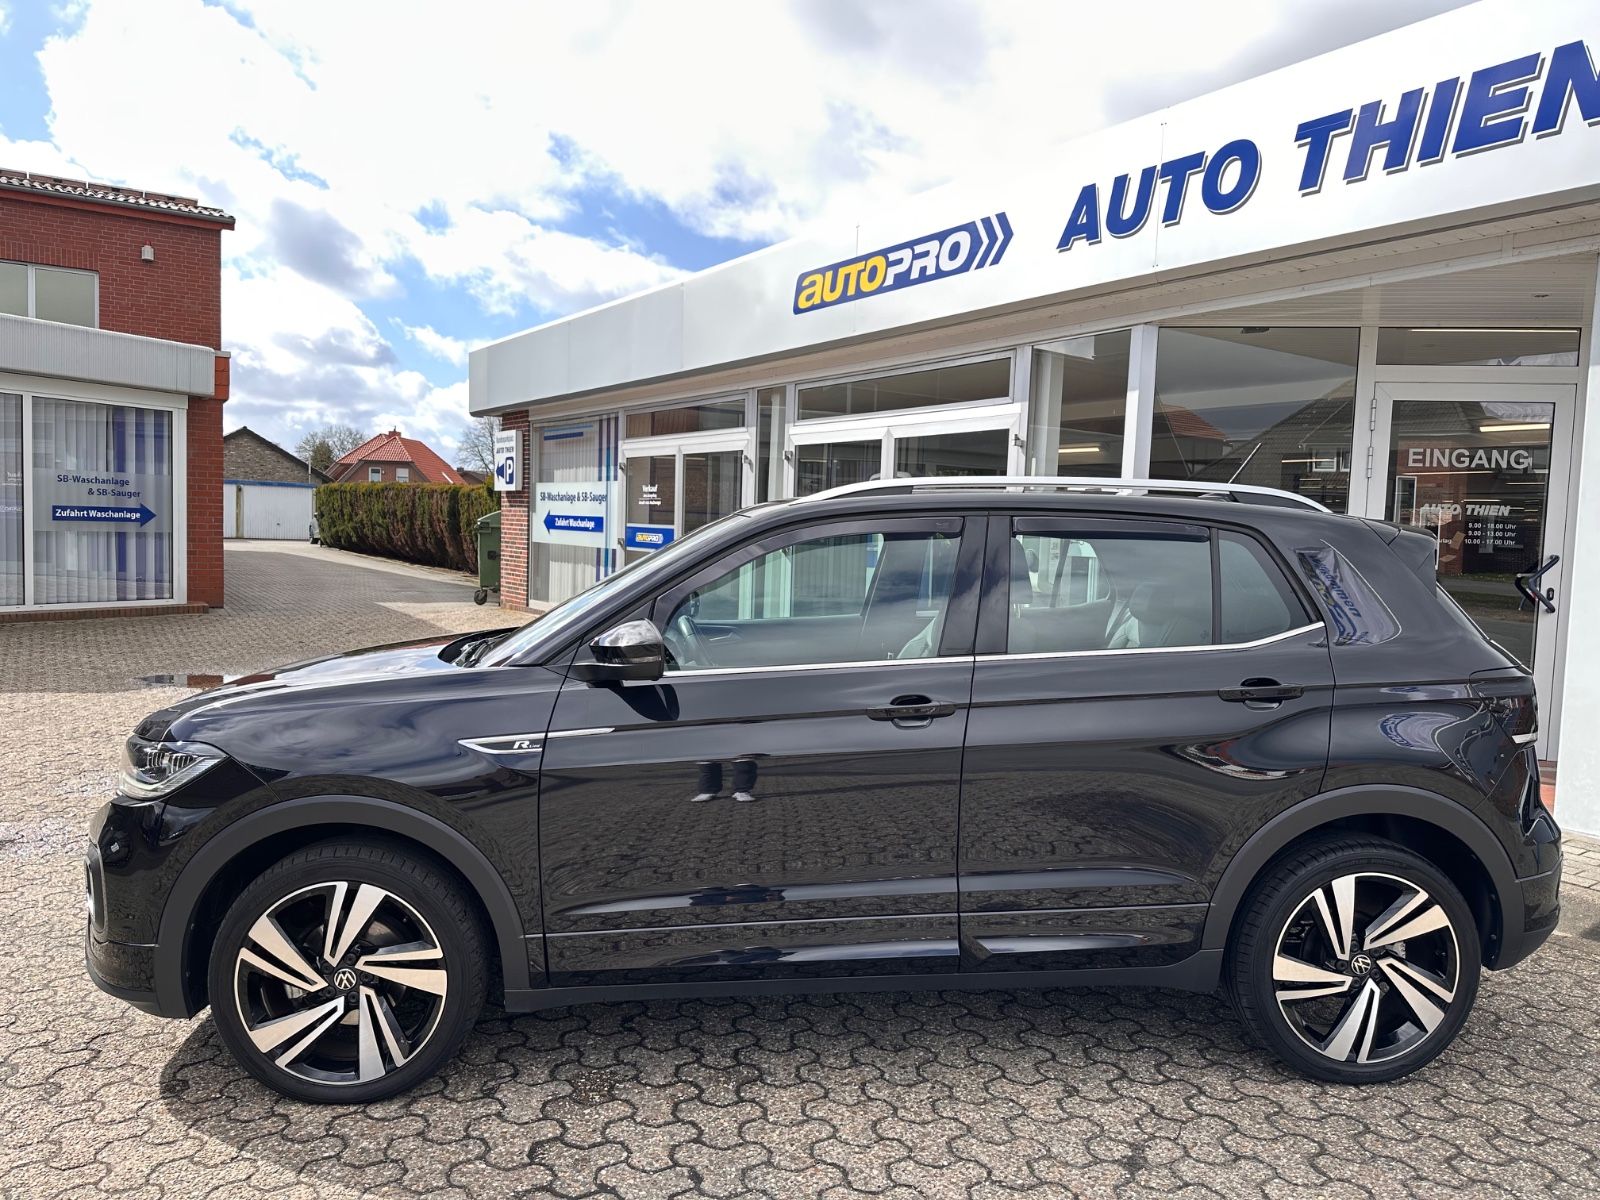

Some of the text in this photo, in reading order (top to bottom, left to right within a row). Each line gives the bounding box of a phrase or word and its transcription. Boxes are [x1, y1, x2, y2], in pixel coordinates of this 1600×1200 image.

[1056, 39, 1600, 252] AUTO THIEN
[1407, 448, 1529, 469] EINGANG
[57, 474, 130, 487] SB-Waschanlage
[87, 488, 141, 499] & SB-Sauger
[540, 491, 576, 504] SB-Waschanlage
[581, 491, 608, 505] SB-Sauger
[56, 508, 141, 520] Zufahrt Waschanlage
[1421, 503, 1511, 517] AUTO THIEN
[555, 517, 595, 530] Zufahrt Waschanlage
[512, 741, 529, 750] R
